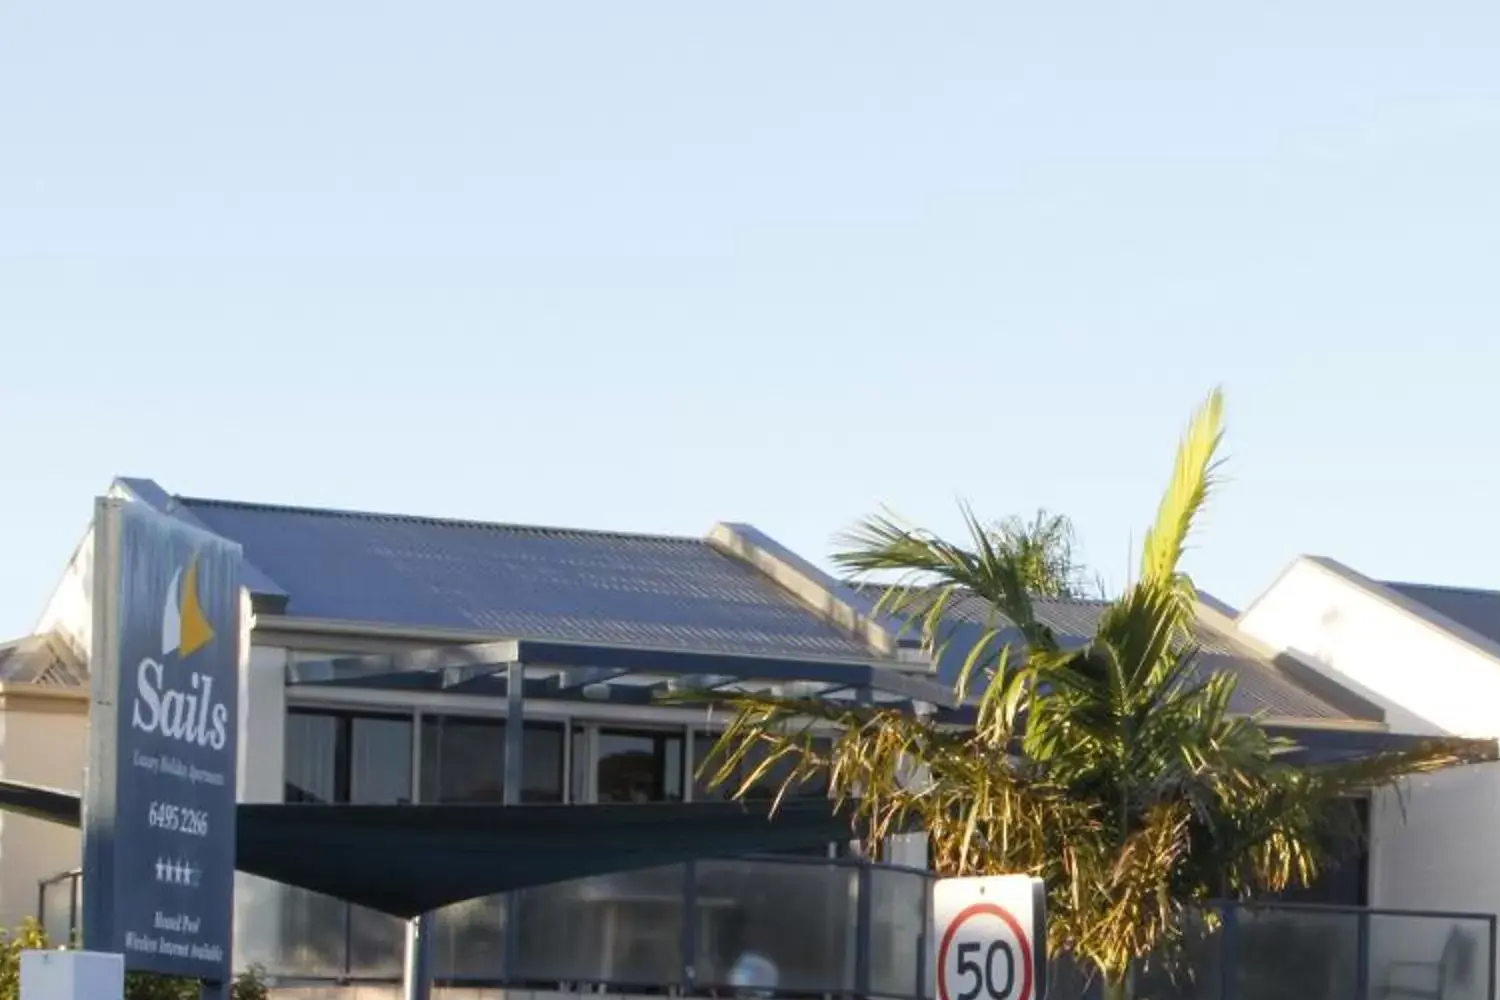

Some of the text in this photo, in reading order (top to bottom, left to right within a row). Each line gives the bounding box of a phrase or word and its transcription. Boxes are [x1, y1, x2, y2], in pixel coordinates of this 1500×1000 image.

[132, 657, 228, 750] Sails
[149, 801, 208, 838] 6495 2266
